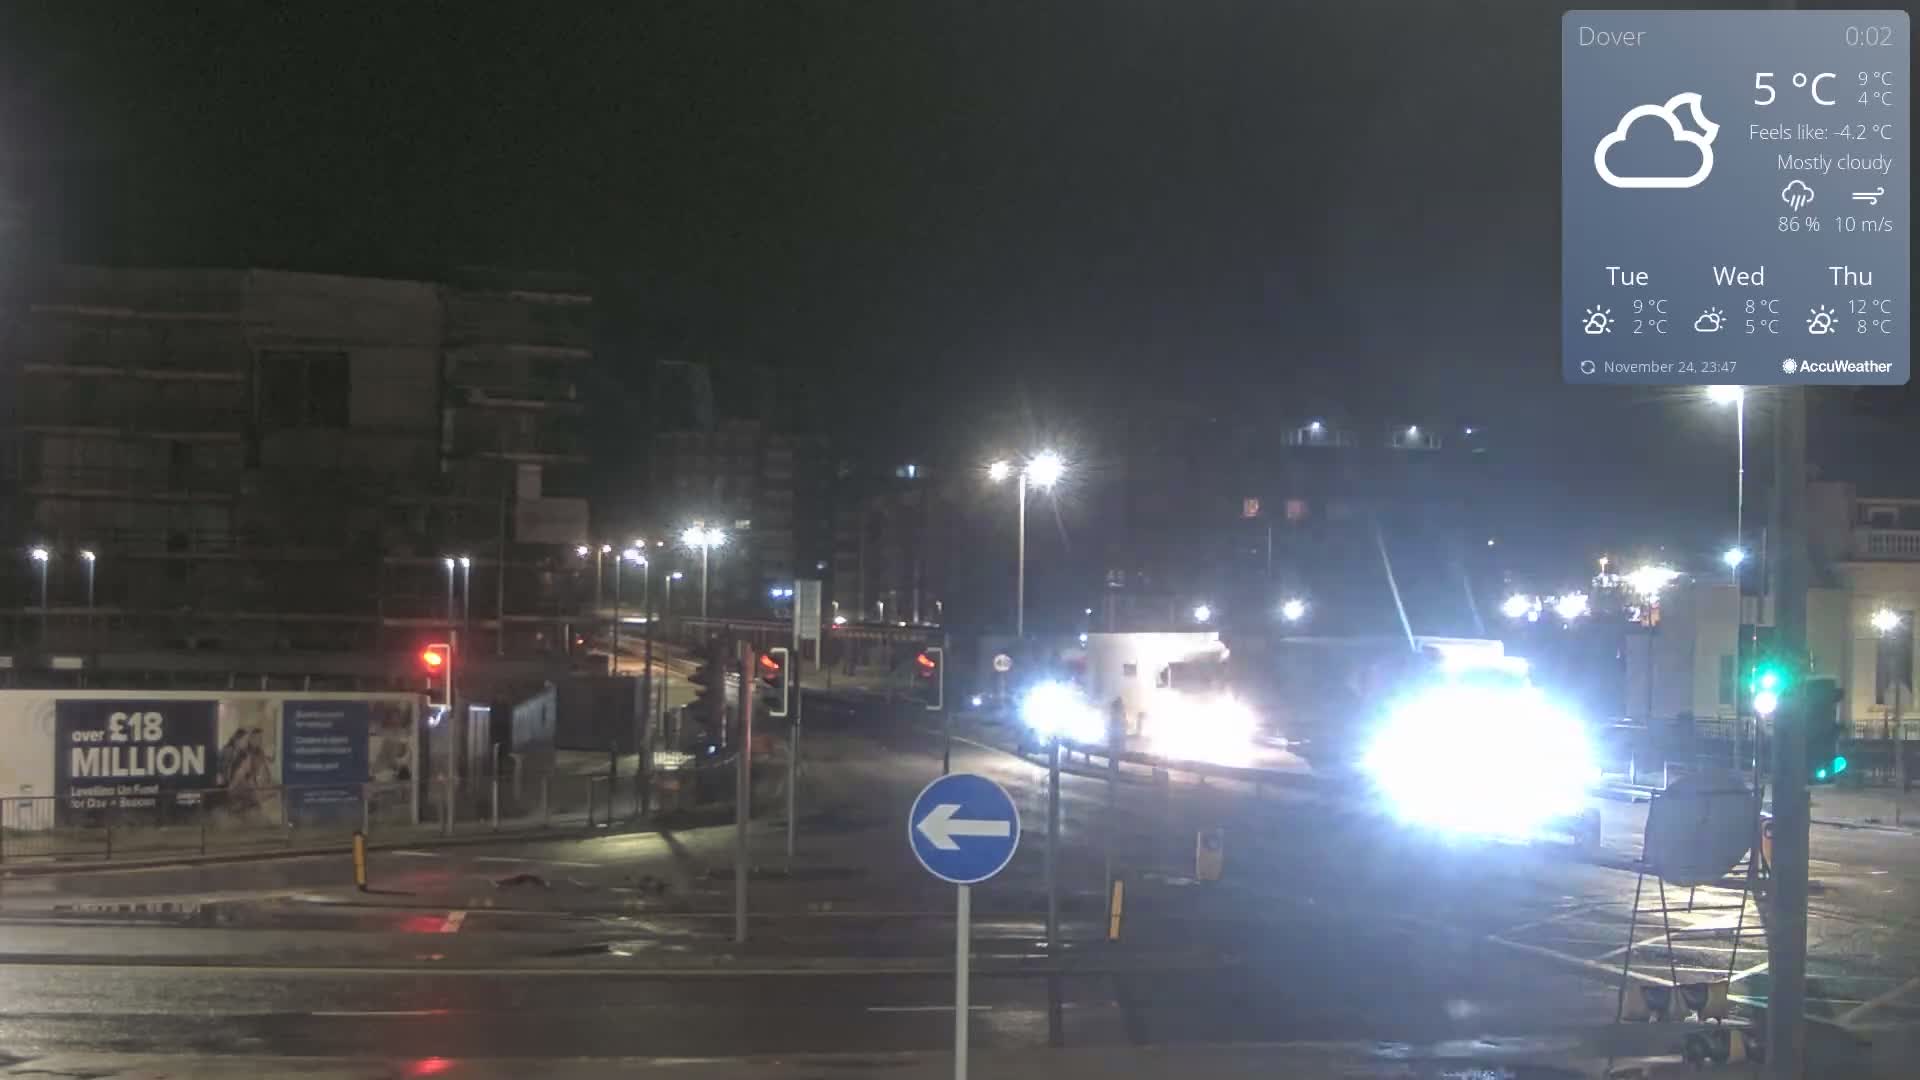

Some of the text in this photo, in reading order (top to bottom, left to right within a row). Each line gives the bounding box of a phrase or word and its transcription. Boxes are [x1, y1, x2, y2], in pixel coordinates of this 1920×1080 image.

[72, 711, 163, 742] over £18
[72, 745, 205, 777] MILLION
